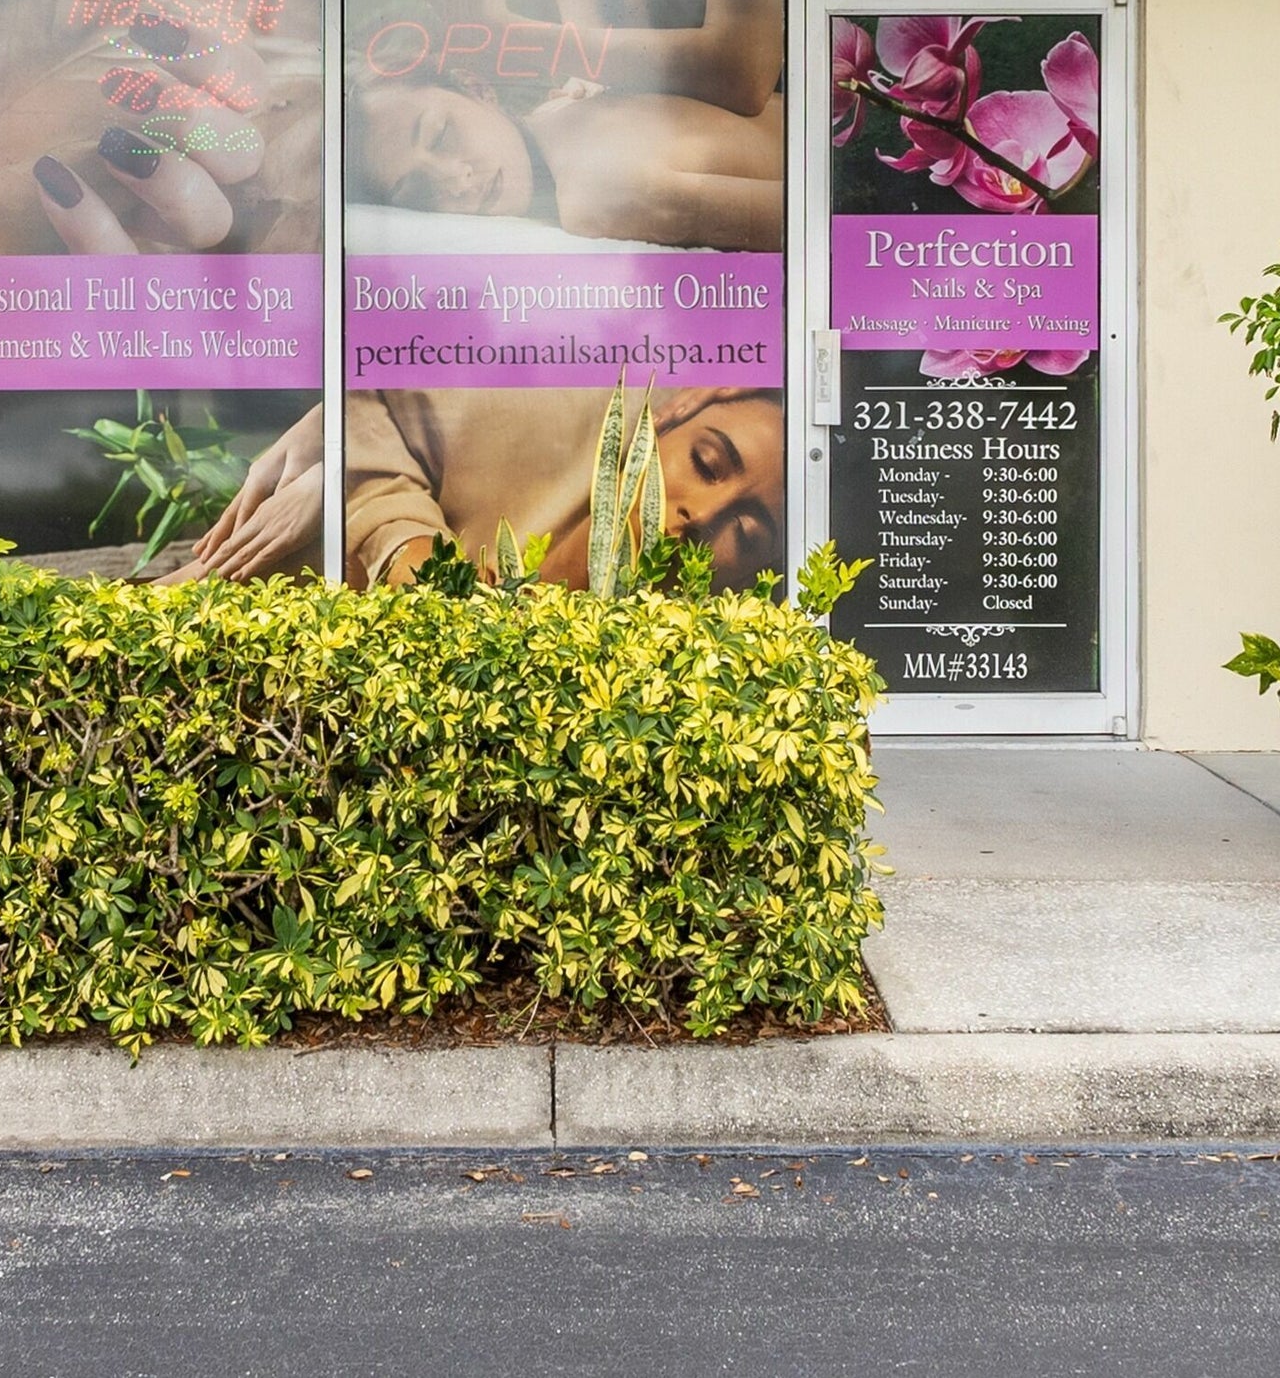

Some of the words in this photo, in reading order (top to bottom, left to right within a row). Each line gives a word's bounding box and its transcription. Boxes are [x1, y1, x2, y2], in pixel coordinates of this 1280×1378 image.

[365, 19, 613, 80] OPEN
[864, 228, 1075, 269] Perfection
[84, 277, 137, 313] Full
[145, 276, 238, 312] Service
[246, 276, 294, 323] Spa
[352, 274, 427, 311] Book
[436, 285, 468, 311] an
[477, 273, 665, 324] Appointment
[673, 272, 770, 310] Online
[910, 277, 967, 299] Nails
[973, 278, 995, 299] &
[1002, 277, 1043, 306] Spa
[849, 314, 918, 336] Massage
[933, 314, 1012, 332] Manicure
[1026, 314, 1091, 335] Waxing
[69, 331, 91, 360] &
[97, 329, 193, 360] Walk-Ins
[199, 329, 300, 359] Welcome
[354, 334, 768, 377] perfectionnailsandspa.net
[853, 400, 1078, 431] 321-338-7442
[870, 436, 974, 462] Business
[981, 436, 1061, 461] Hours
[878, 467, 939, 486] Monday
[982, 467, 1058, 483] 9:30-6:00
[878, 488, 945, 508] Tuesday-
[982, 488, 1058, 504] 9:30-6:00
[878, 509, 967, 529] Wednesday-
[982, 509, 1058, 525] 9:30-6:00
[878, 530, 953, 550] Thursday-
[982, 530, 1058, 546] 9:30-6:00
[878, 552, 932, 572] Friday-
[982, 552, 1058, 568] 9:30-6:00
[878, 573, 949, 593] Saturday-
[982, 573, 1058, 589] 9:30-6:00
[878, 594, 938, 614] Sunday-
[982, 594, 1034, 611] Closed
[902, 652, 1029, 682] MM#33143
